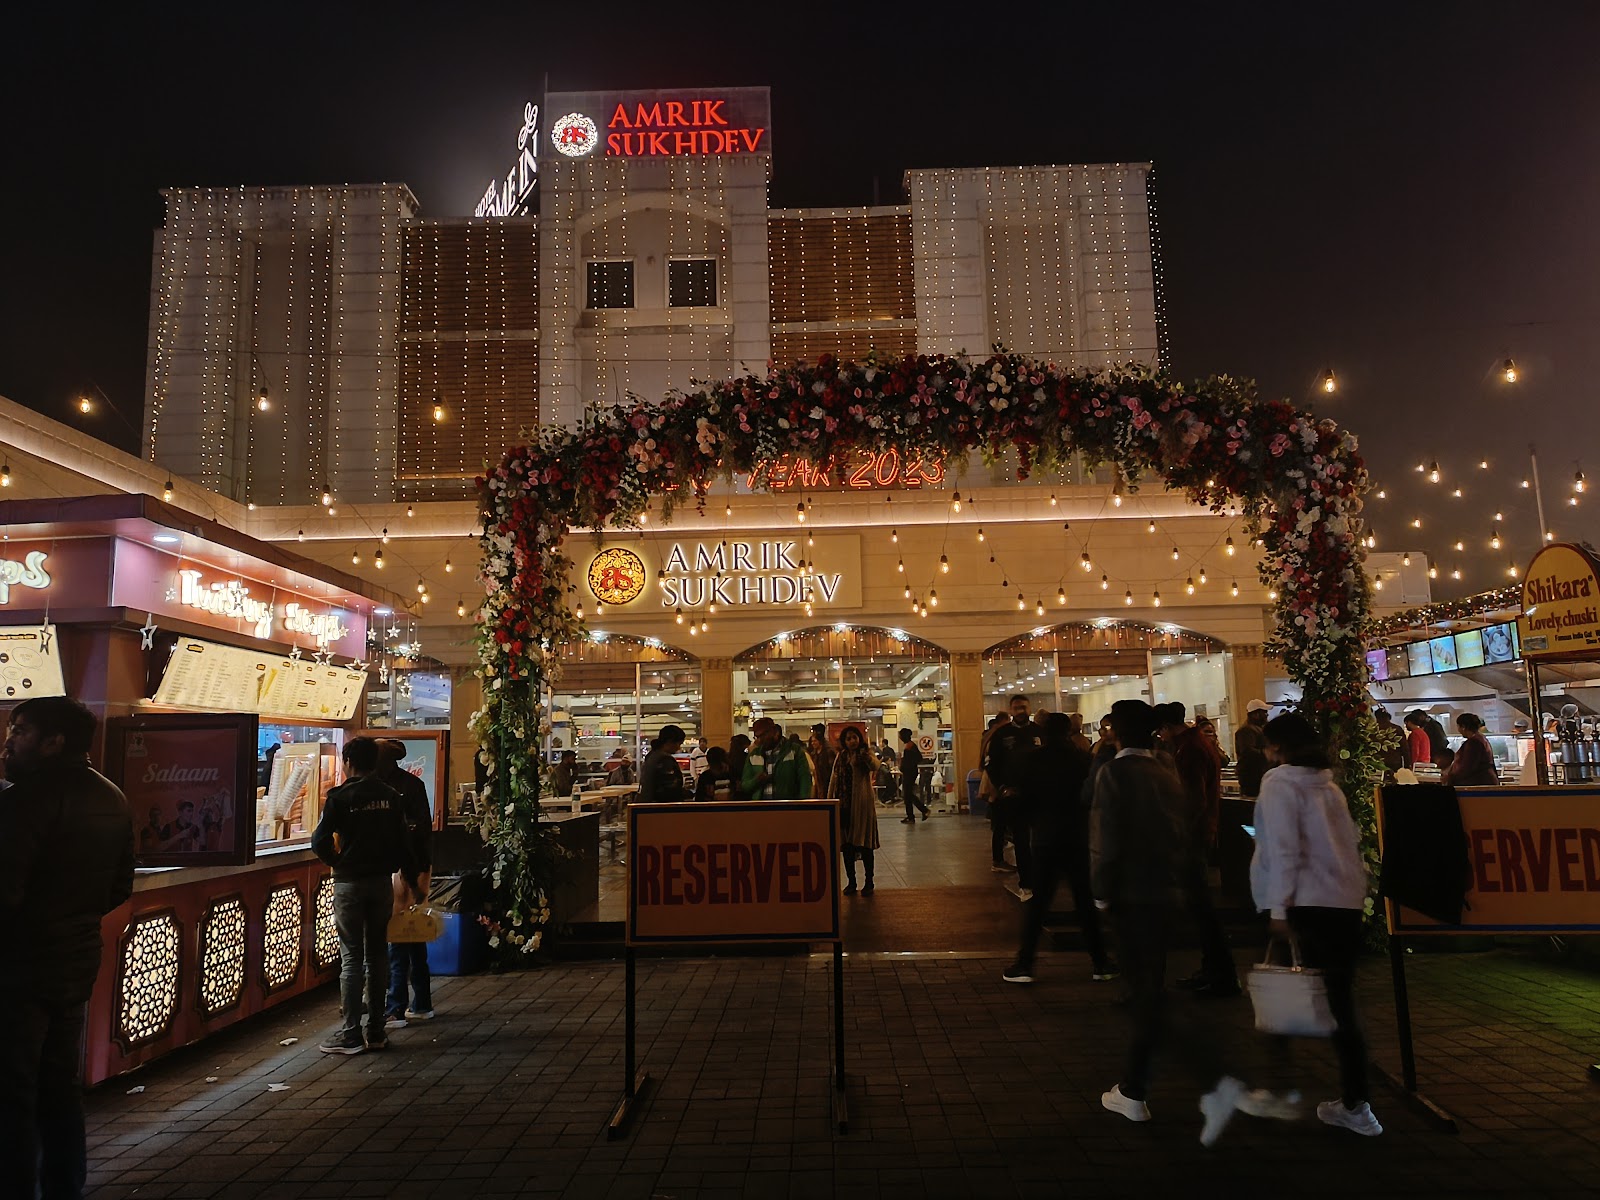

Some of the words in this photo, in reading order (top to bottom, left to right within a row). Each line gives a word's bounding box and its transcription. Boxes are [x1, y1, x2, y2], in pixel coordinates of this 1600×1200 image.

[607, 100, 728, 128] AMRIK
[606, 128, 765, 156] SUKHDEV
[849, 448, 947, 486] 2023
[665, 541, 799, 572] AMRIK
[662, 574, 842, 607] SUKHDEV
[1527, 575, 1592, 605] Shikara
[142, 762, 220, 784] Salaam
[639, 841, 826, 905] RESERVED
[1466, 828, 1600, 893] ERVED
